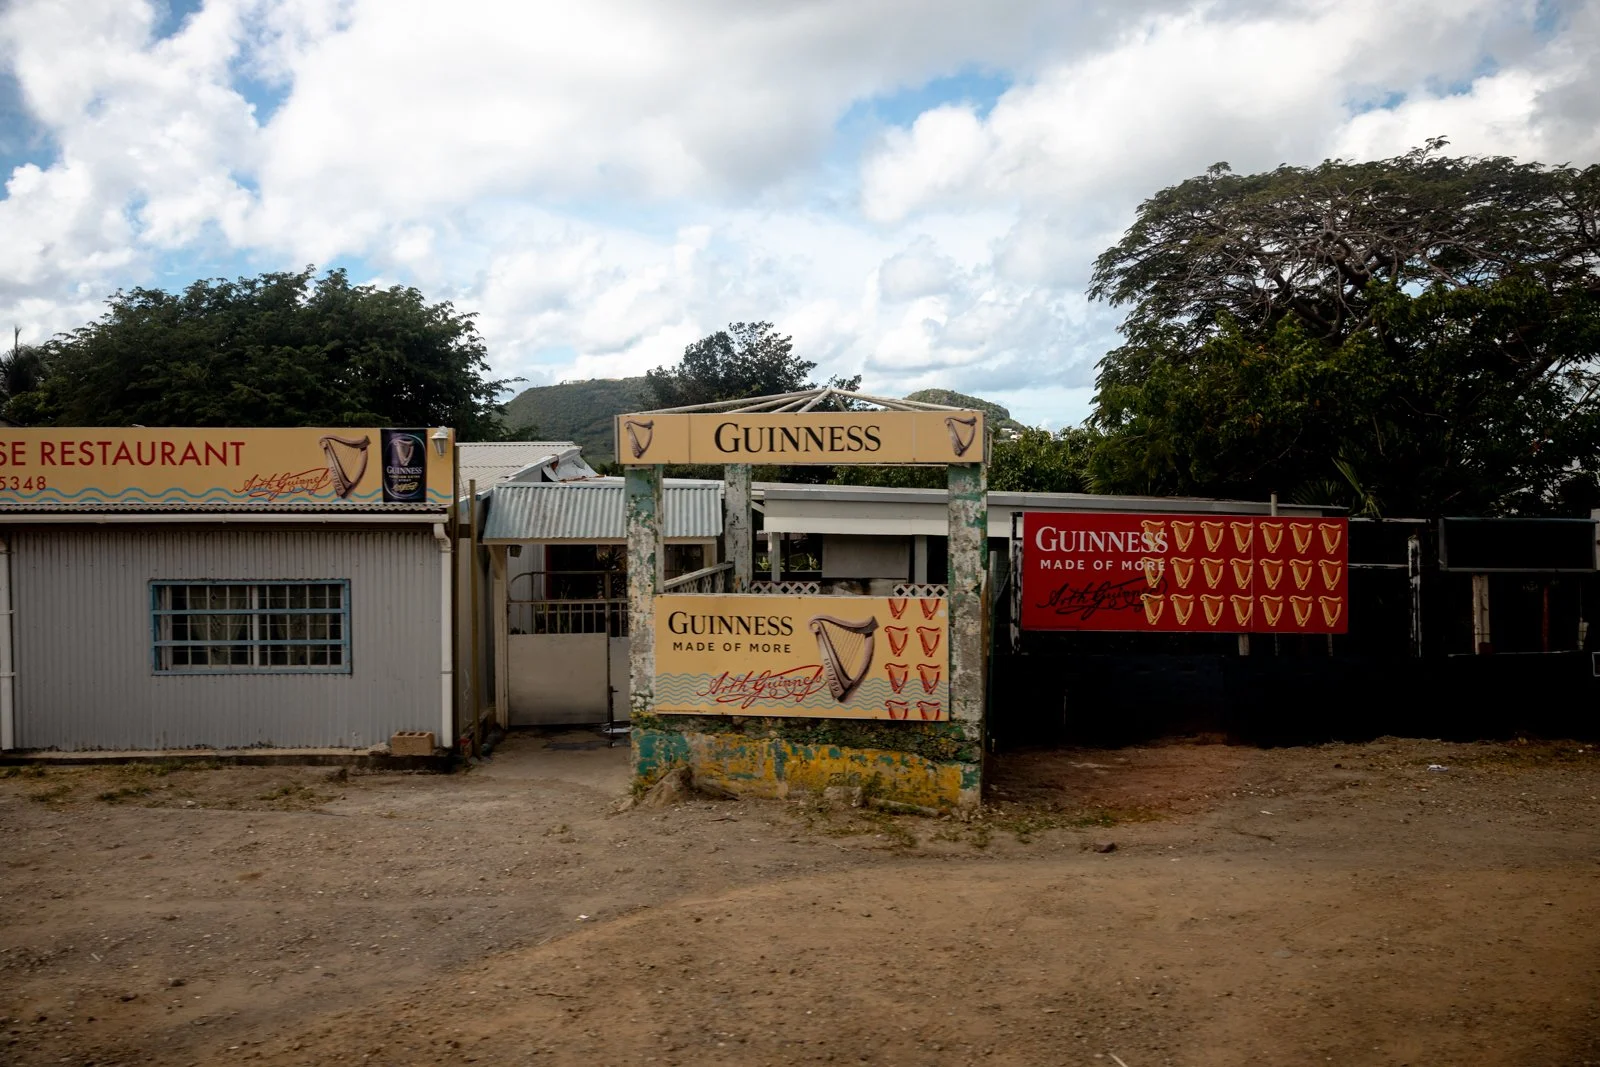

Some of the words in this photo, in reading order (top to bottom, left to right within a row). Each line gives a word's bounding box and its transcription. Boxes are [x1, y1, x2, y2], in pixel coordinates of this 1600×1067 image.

[714, 422, 882, 453] GUINNESS
[40, 441, 245, 466] RESTAURANT
[386, 466, 423, 475] GUINNESS
[1035, 525, 1169, 553] GUINNESS
[1040, 559, 1085, 570] MADE
[1093, 560, 1113, 571] OF
[1121, 561, 1166, 571] MORE
[668, 611, 793, 636] GUINNESS
[673, 642, 715, 652] MADE
[723, 643, 741, 652] OF
[750, 643, 791, 653] MORE
